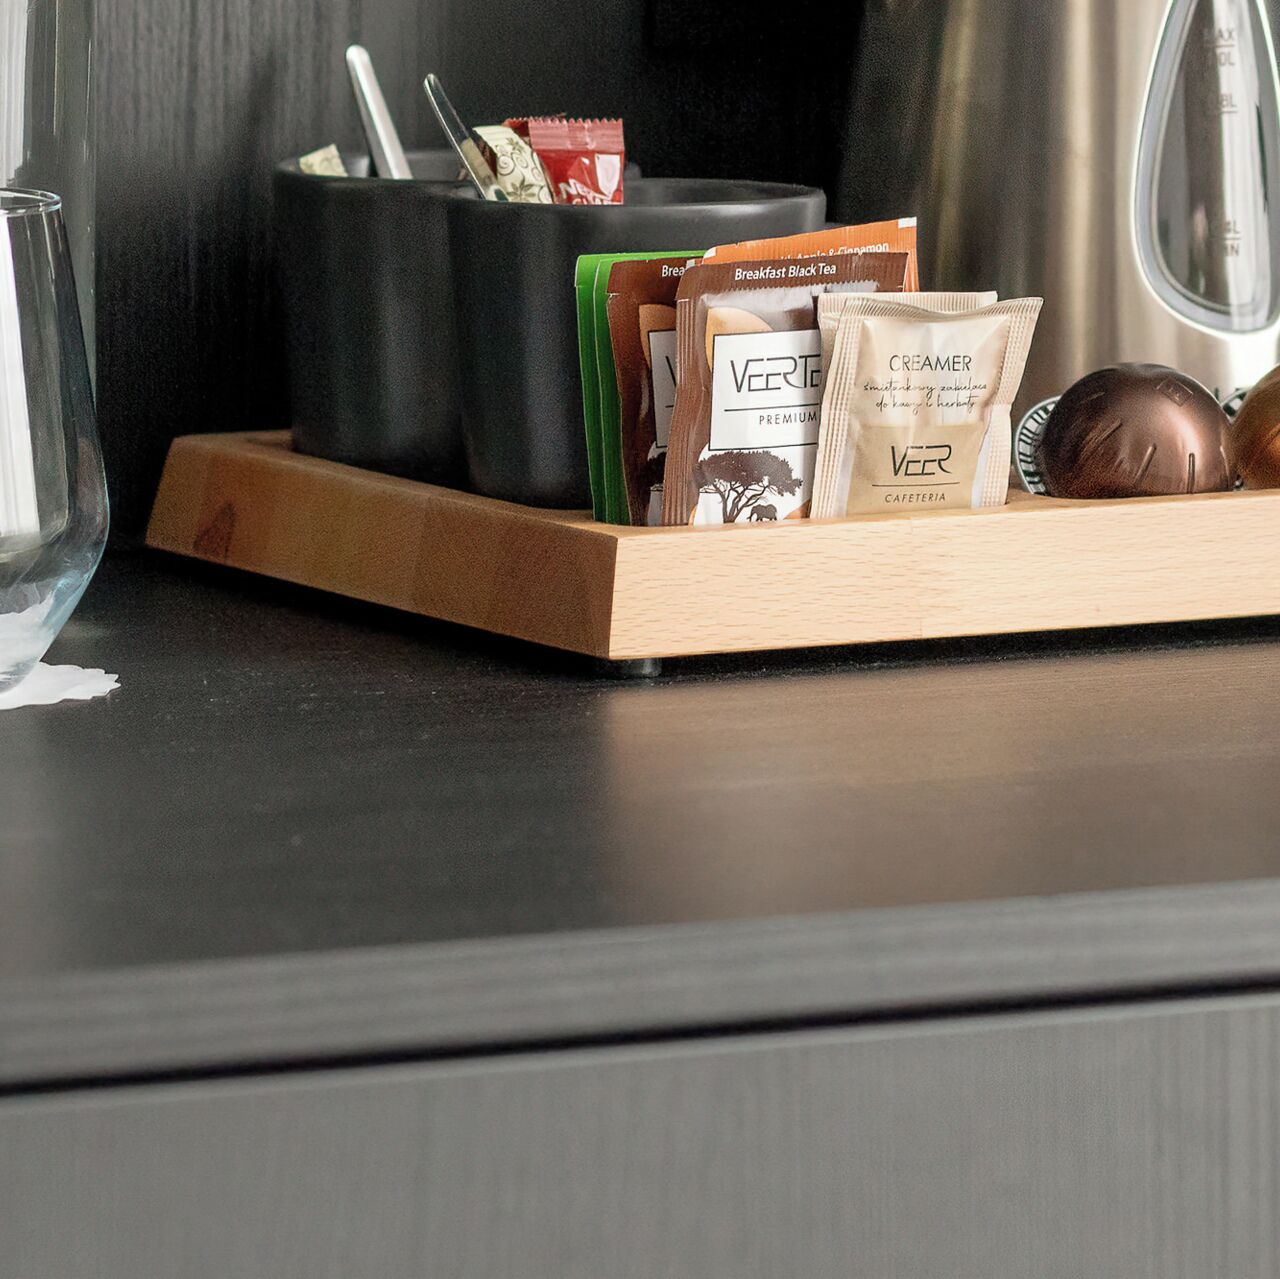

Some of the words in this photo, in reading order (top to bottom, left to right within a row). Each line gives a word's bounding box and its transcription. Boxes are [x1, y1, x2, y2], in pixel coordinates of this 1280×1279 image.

[661, 265, 686, 278] Brea
[734, 267, 786, 281] Breakfast
[789, 265, 816, 278] Black
[818, 263, 837, 275] Tea
[889, 354, 972, 371] CREAMER
[759, 413, 817, 425] PREMIUM
[891, 444, 952, 477] VEER
[885, 493, 946, 503] CAFETERIA
